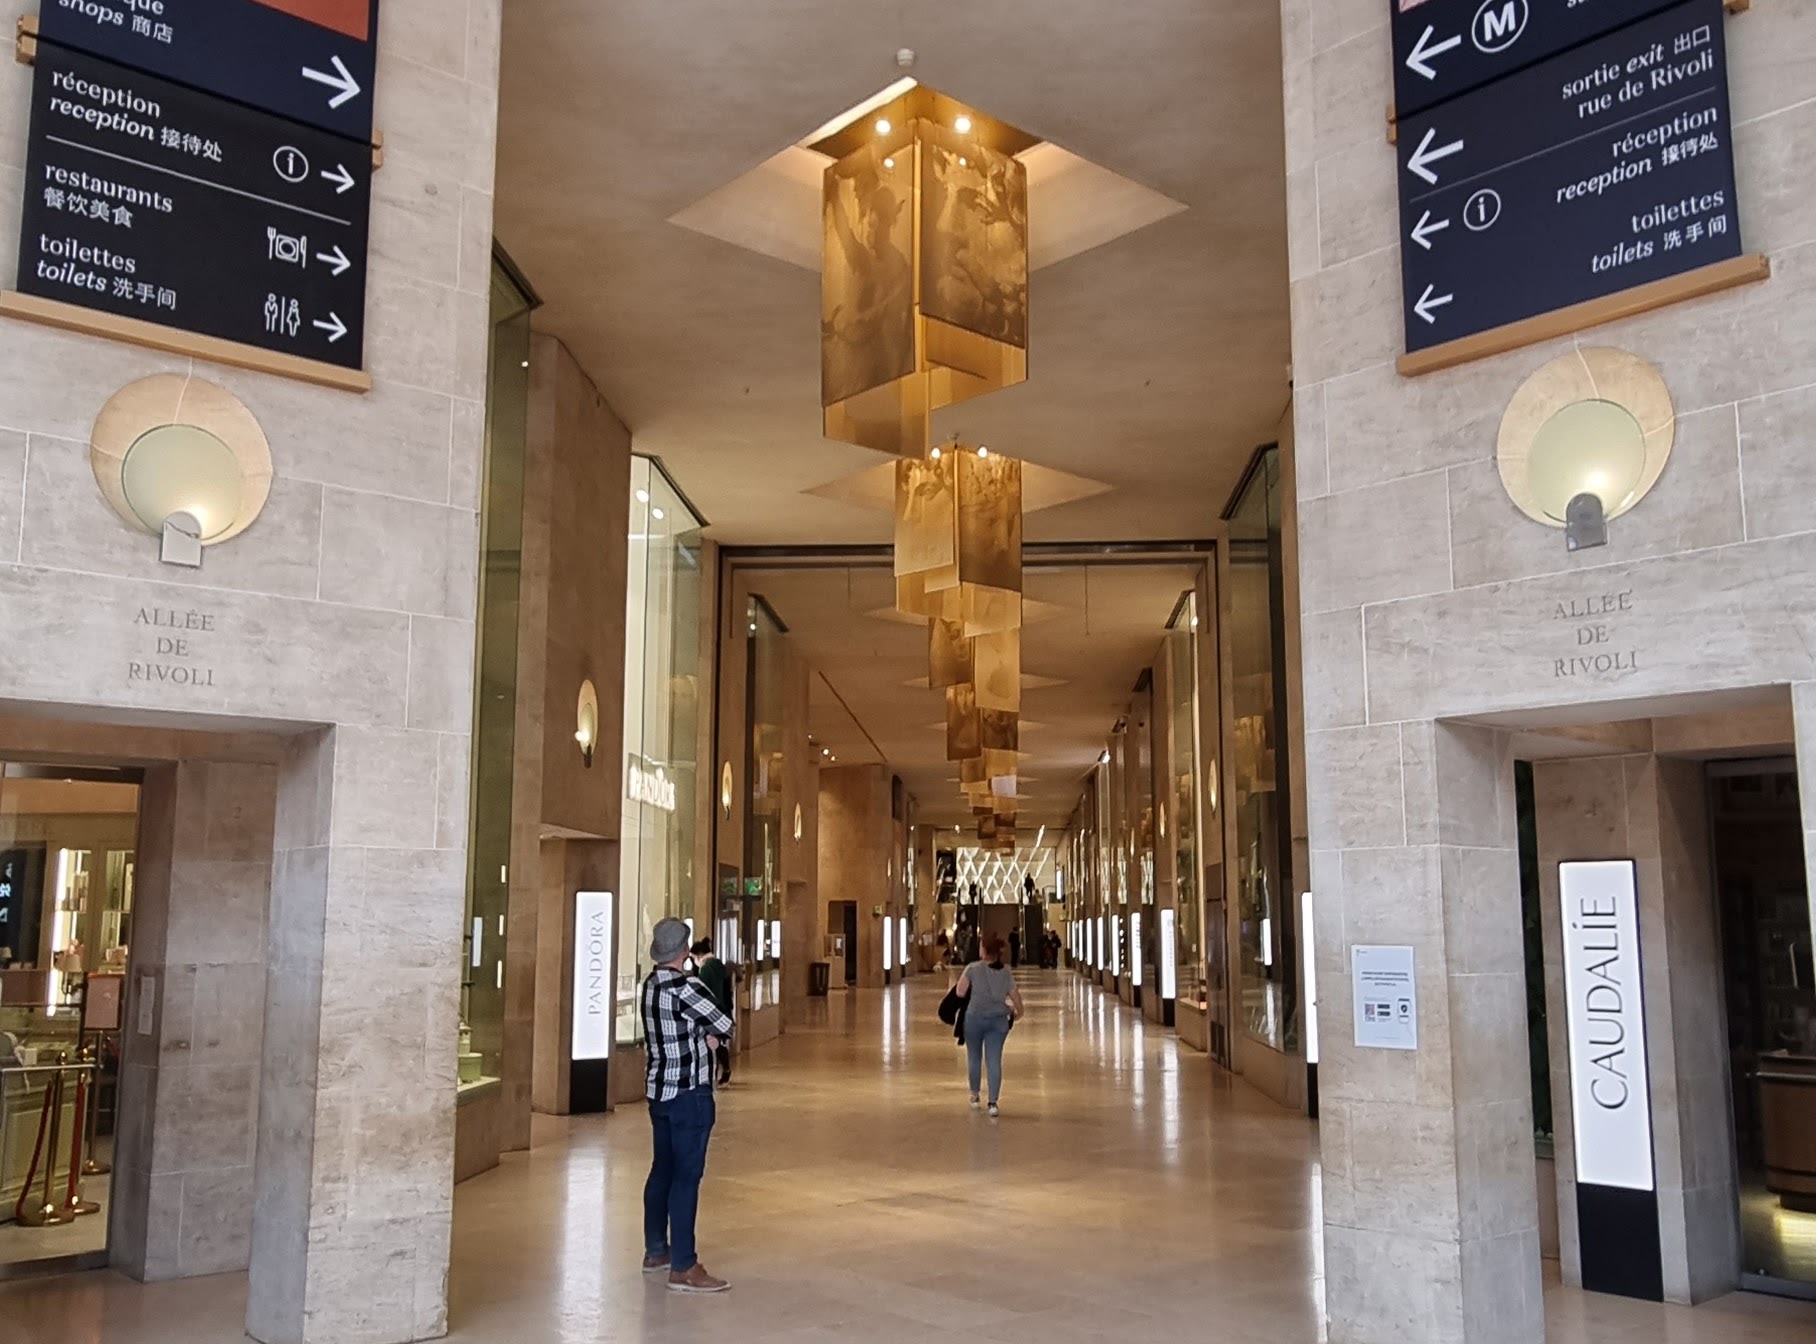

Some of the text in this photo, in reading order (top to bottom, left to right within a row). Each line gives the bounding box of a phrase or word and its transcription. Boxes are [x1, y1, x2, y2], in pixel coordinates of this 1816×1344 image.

[132, 14, 173, 44] 商店
[1482, 2, 1516, 42] M
[1562, 25, 1711, 99] sortie exit 出口
[1577, 48, 1714, 119] rue de Rivoli
[52, 69, 161, 118] réception
[50, 95, 223, 163] reception 接待处
[1612, 106, 1718, 157] réception
[44, 162, 174, 213] restaurants
[1556, 156, 1653, 203] reception
[1631, 190, 1725, 233] toilettes
[39, 233, 136, 273] toilettes
[1591, 215, 1728, 274] toilets 洗手间
[36, 259, 177, 311] toilets 洗手间
[156, 636, 189, 656] DE
[1576, 625, 1610, 646] DE
[128, 662, 216, 686] RIVOLI
[1554, 650, 1637, 678] RIVOLI
